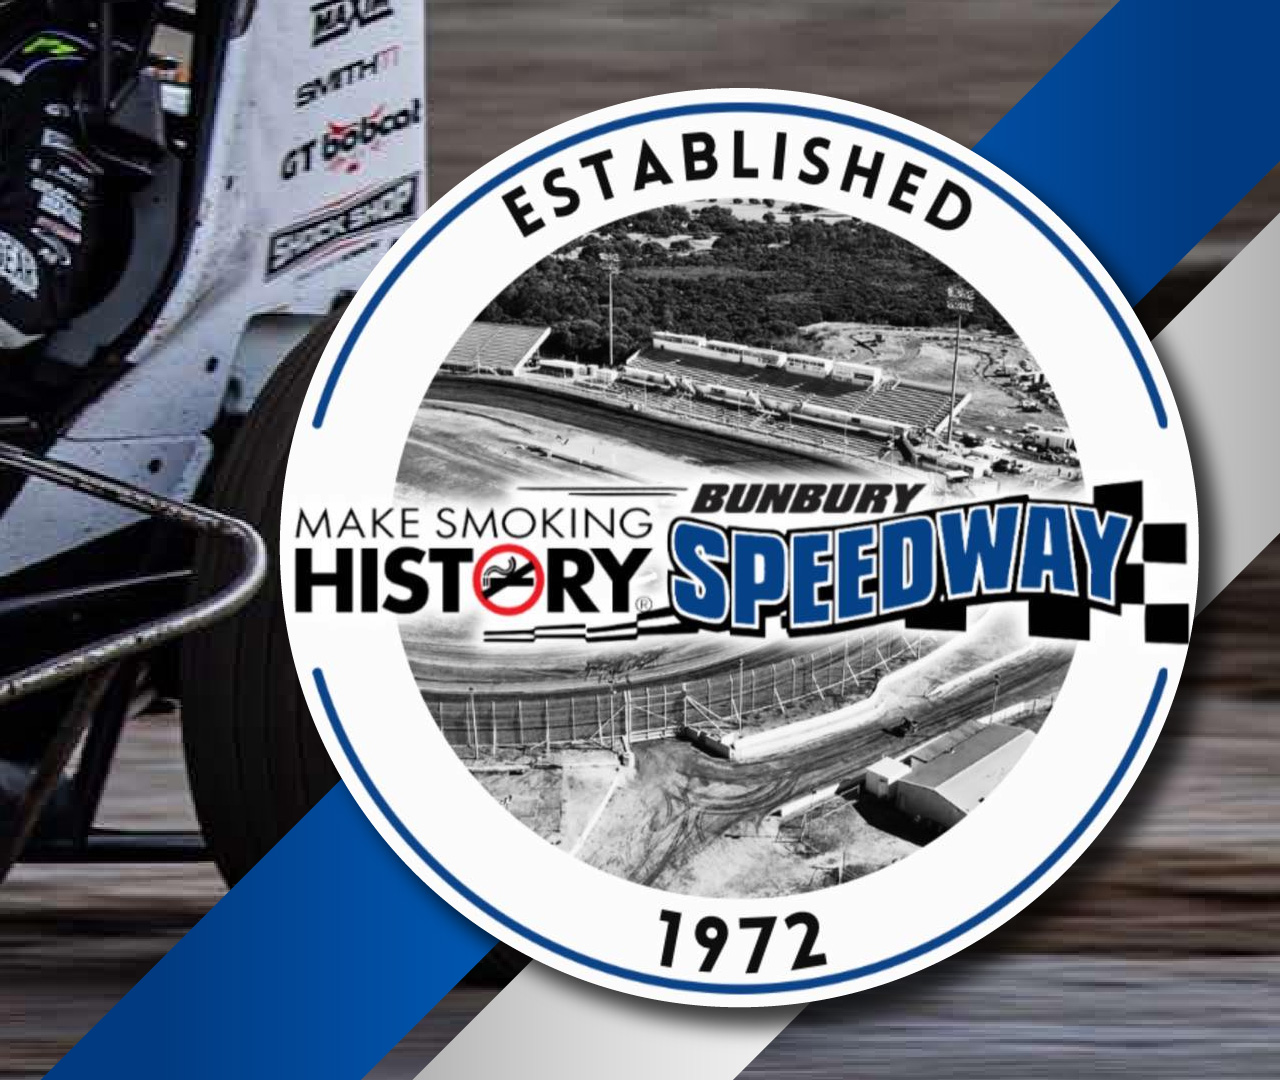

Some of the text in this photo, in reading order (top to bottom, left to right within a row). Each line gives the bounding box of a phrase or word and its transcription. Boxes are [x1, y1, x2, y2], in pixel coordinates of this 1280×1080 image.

[280, 97, 422, 181] GT bobcat
[347, 183, 414, 231] SHOP
